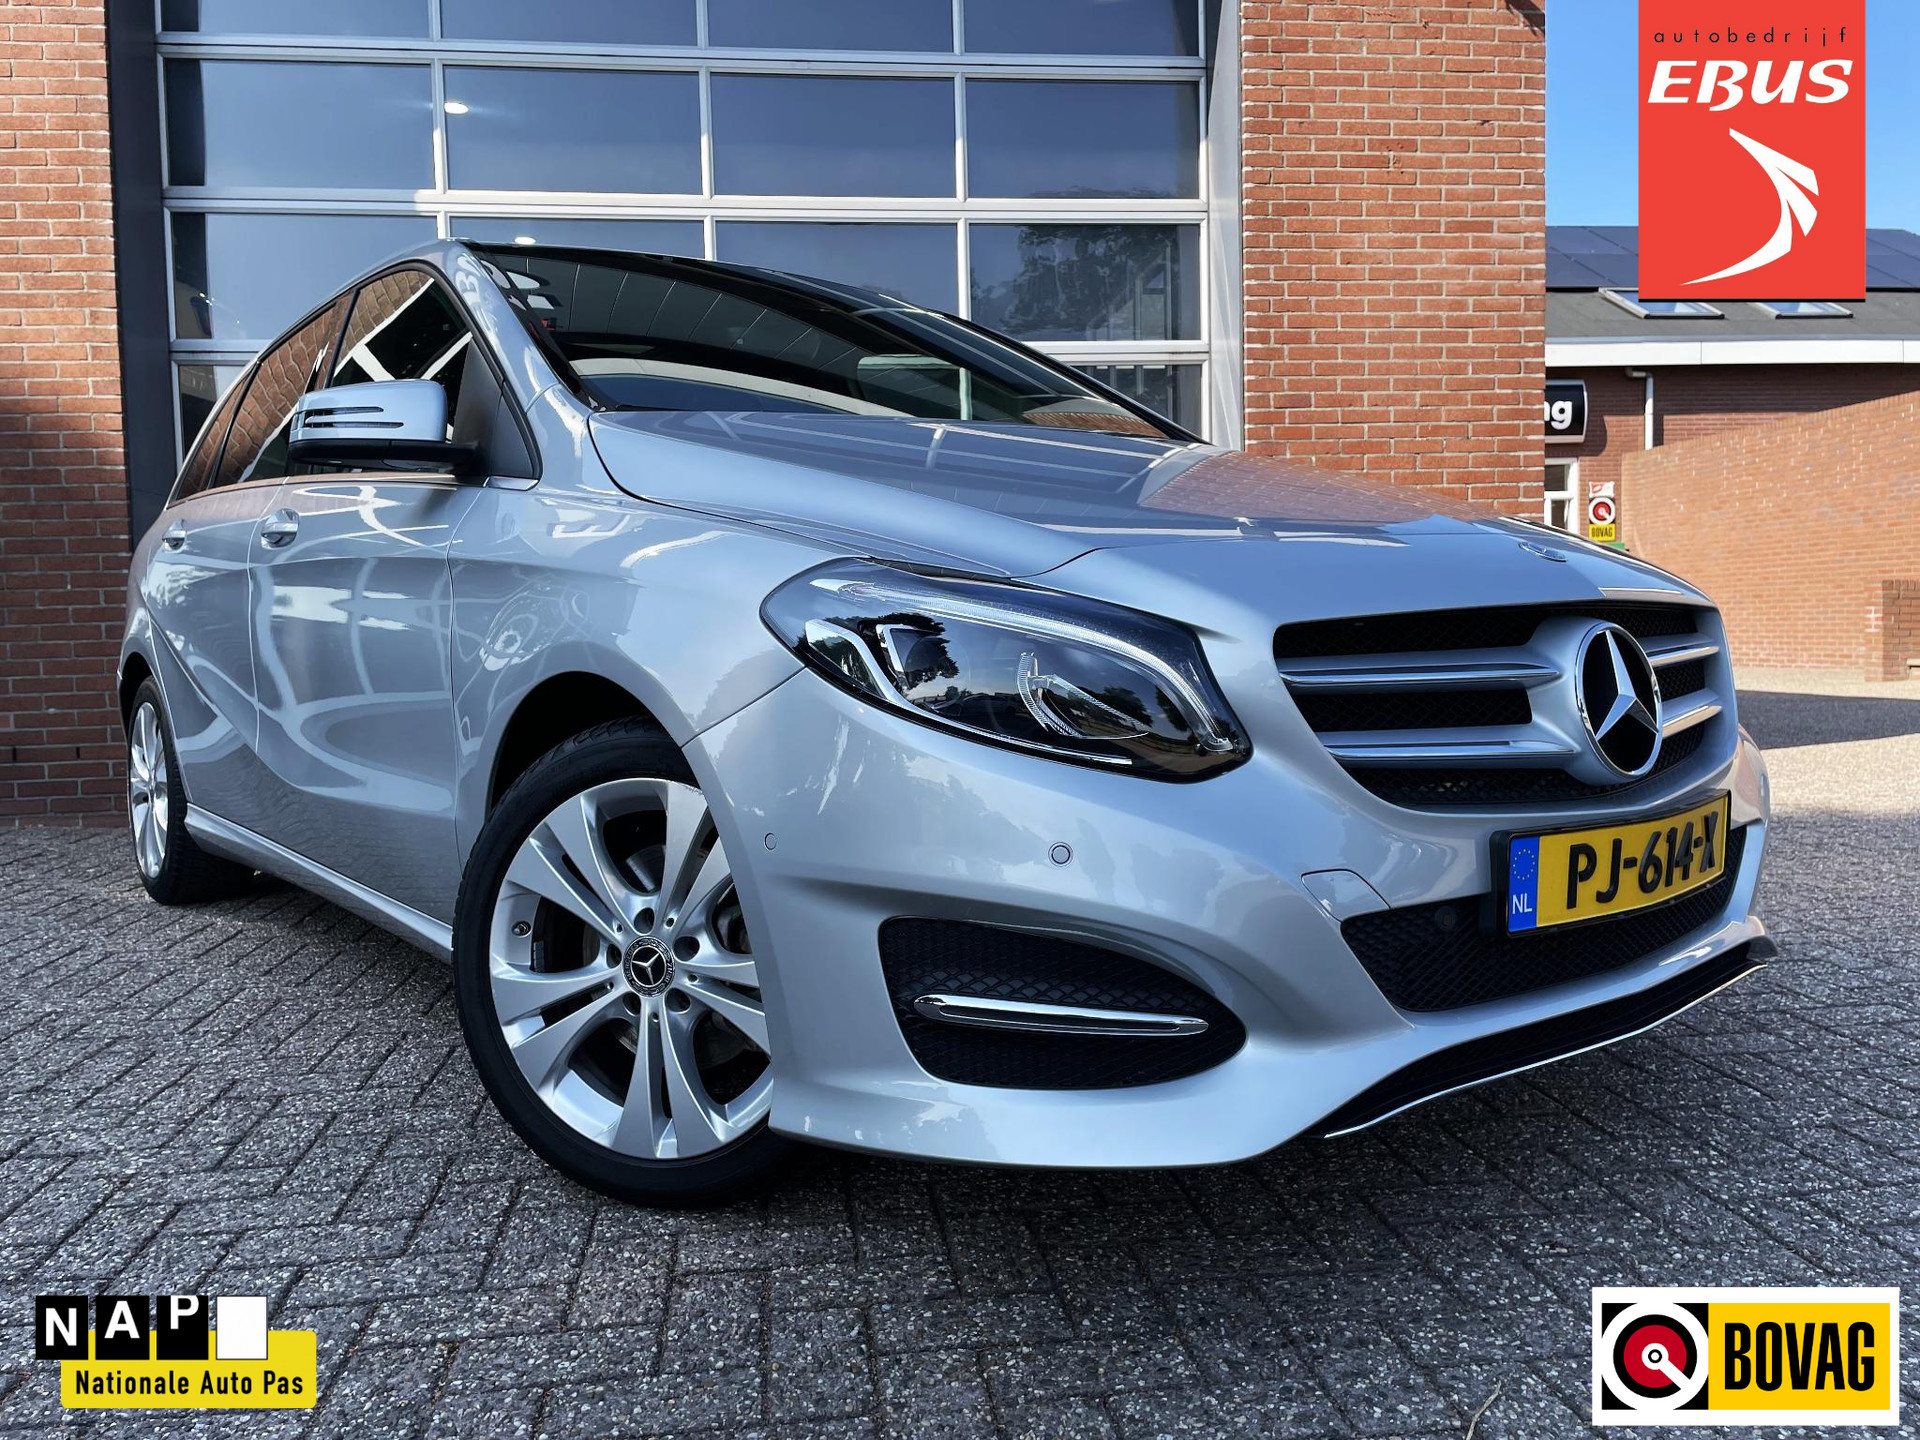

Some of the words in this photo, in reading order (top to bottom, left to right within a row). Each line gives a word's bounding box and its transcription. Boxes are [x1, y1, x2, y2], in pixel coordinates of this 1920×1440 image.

[1591, 527, 1613, 538] BOVAG
[1566, 811, 1718, 910] PJ-614-X
[1512, 893, 1533, 915] NL
